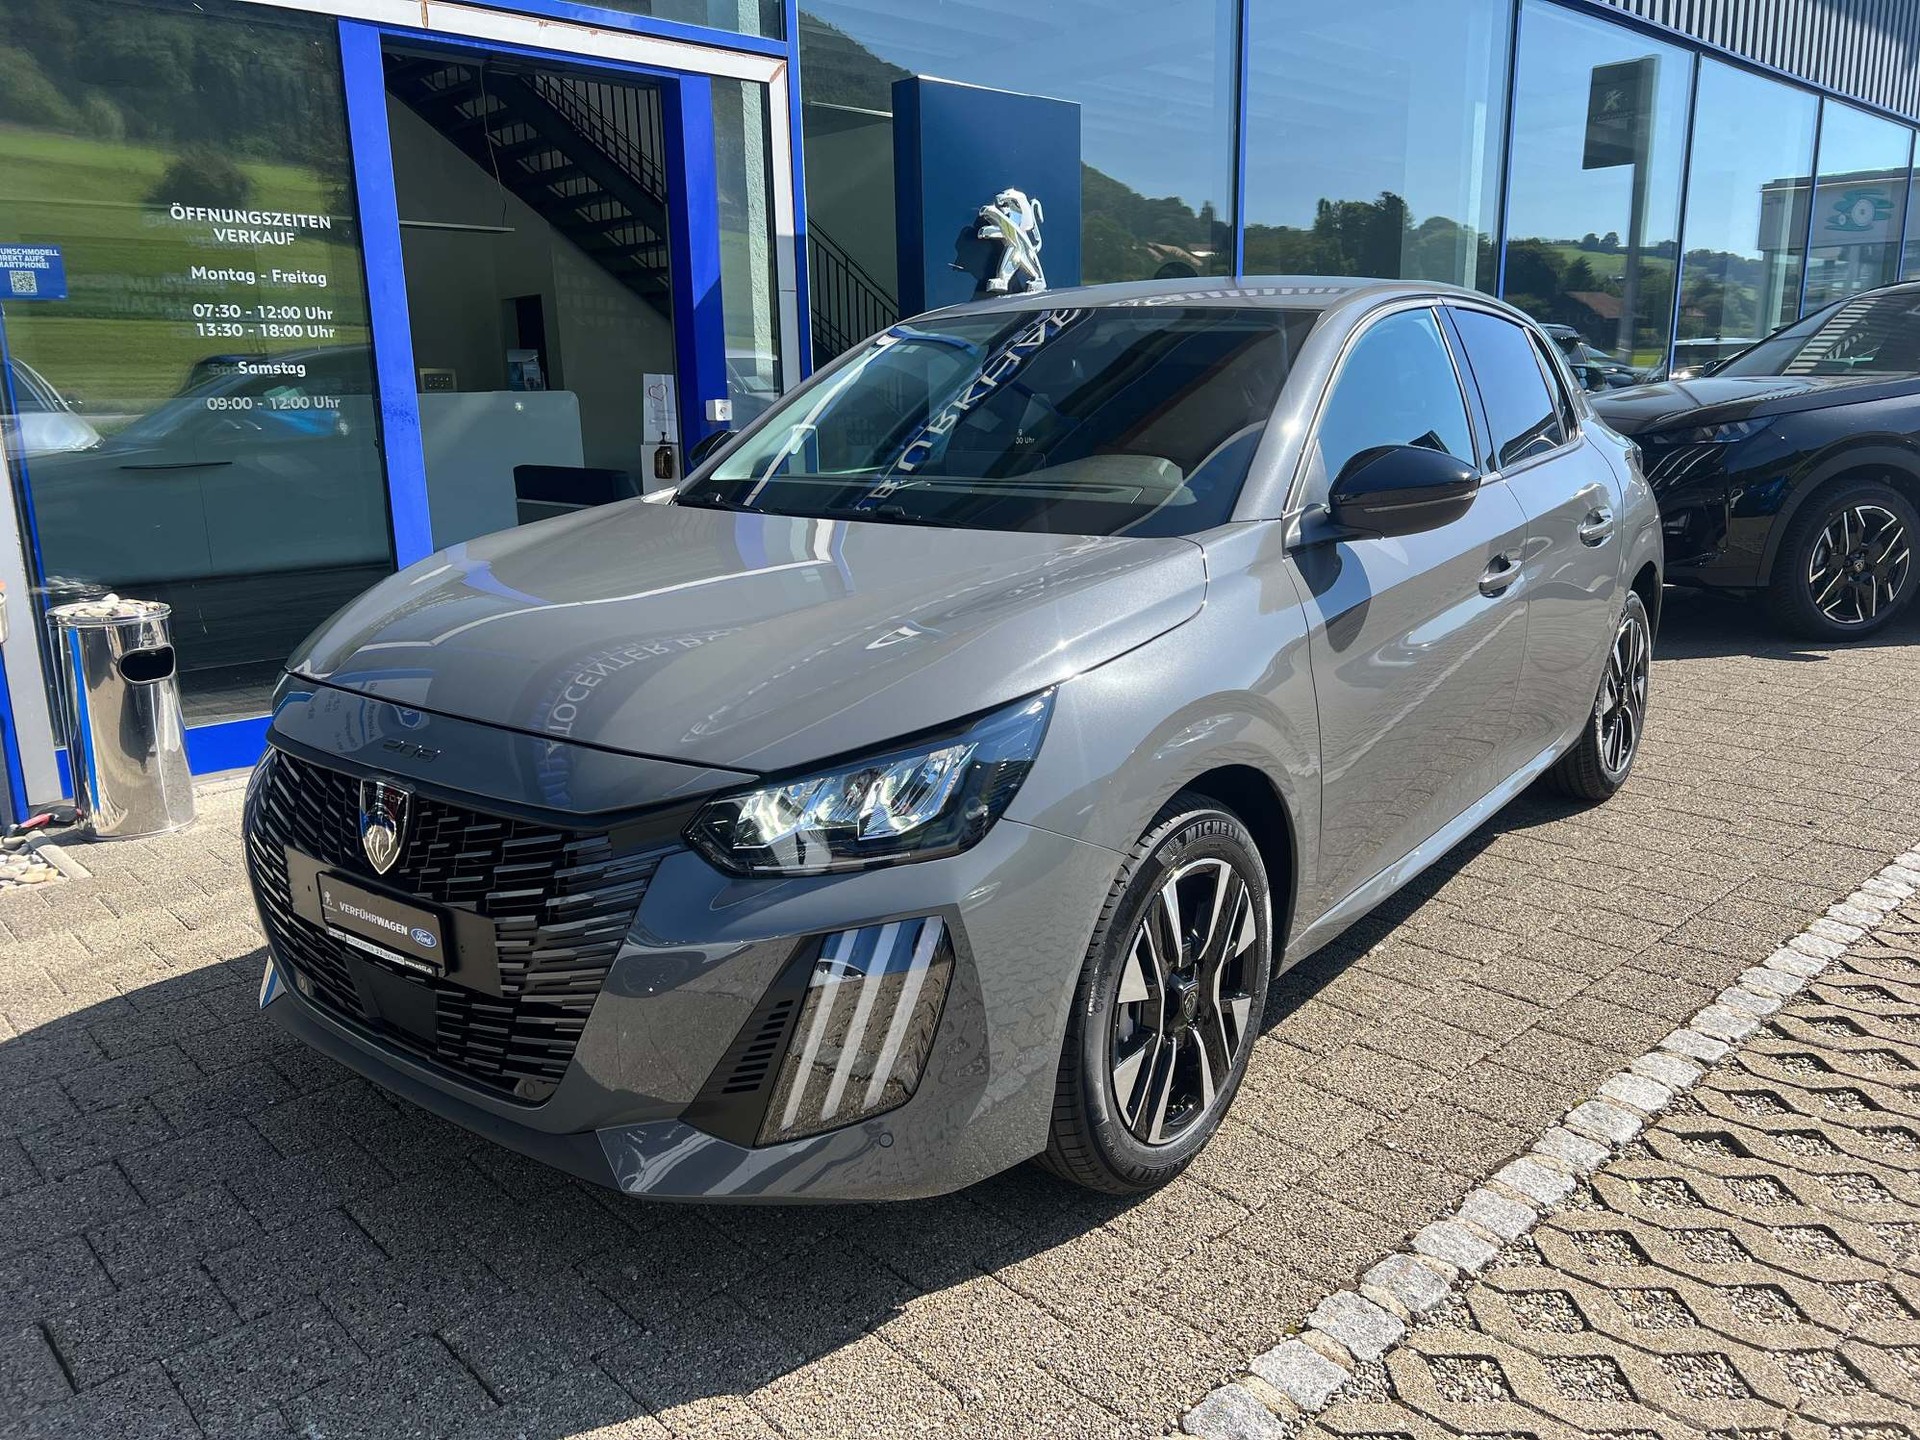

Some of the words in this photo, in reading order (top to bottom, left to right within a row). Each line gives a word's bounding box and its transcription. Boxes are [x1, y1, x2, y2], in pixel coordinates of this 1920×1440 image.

[170, 202, 331, 229] ÖFFNUNGSZEITEN
[213, 228, 295, 245] VERKAUF
[0, 248, 60, 256] UNSCHMODELL
[0, 261, 50, 269] MARTPHONE!
[190, 266, 256, 285] Montag
[272, 269, 328, 288] Freitag
[192, 303, 241, 318] 07:30
[257, 305, 301, 319] 12:00
[305, 306, 334, 320] Uhr
[196, 323, 243, 337] 13:30
[260, 324, 303, 338] 18:00
[307, 325, 336, 338] Uhr
[238, 361, 306, 377] Samstag
[206, 397, 253, 410] 09:00
[270, 395, 310, 410] 12:00
[313, 396, 341, 409] Uhr
[1185, 820, 1249, 849] MICHELIN
